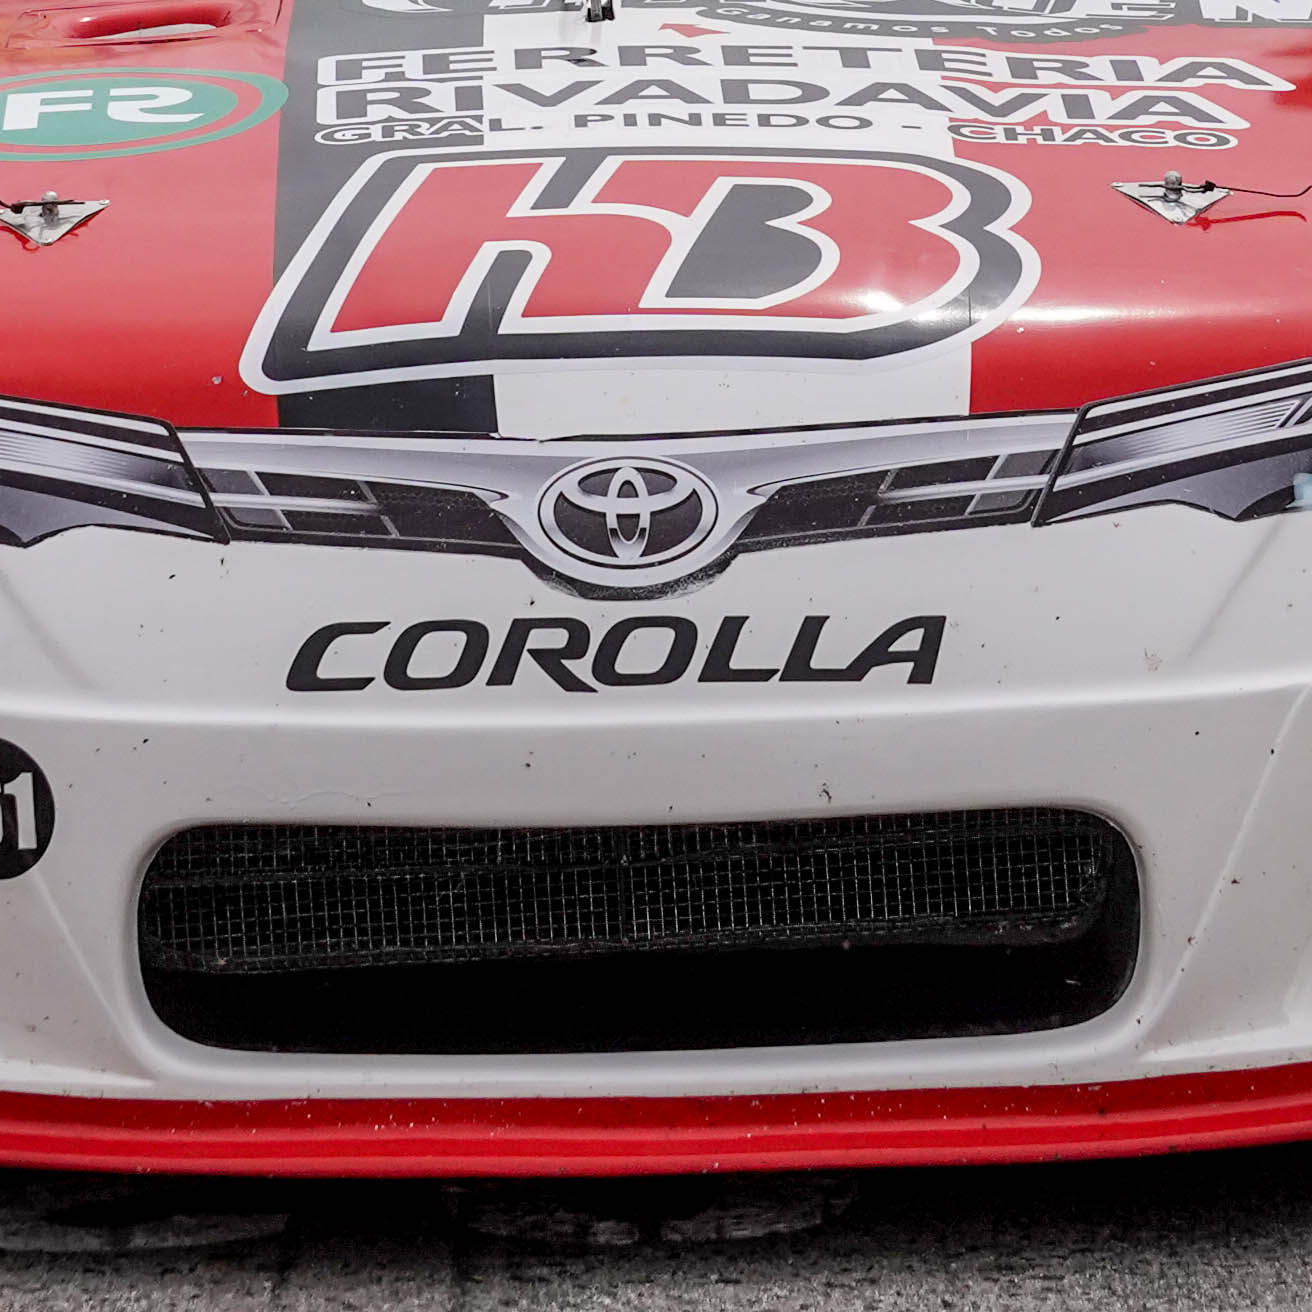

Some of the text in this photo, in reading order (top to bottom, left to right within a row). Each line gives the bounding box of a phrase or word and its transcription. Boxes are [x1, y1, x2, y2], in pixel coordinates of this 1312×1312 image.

[716, 6, 1123, 39] Ganamos Todos
[329, 43, 1286, 88] FERRETERIA
[331, 78, 1230, 126] RIVADAVIA
[322, 118, 543, 144] GRAL.
[574, 112, 874, 131] PINEDO
[949, 124, 1235, 148] CHACO
[285, 615, 947, 694] COROLLA
